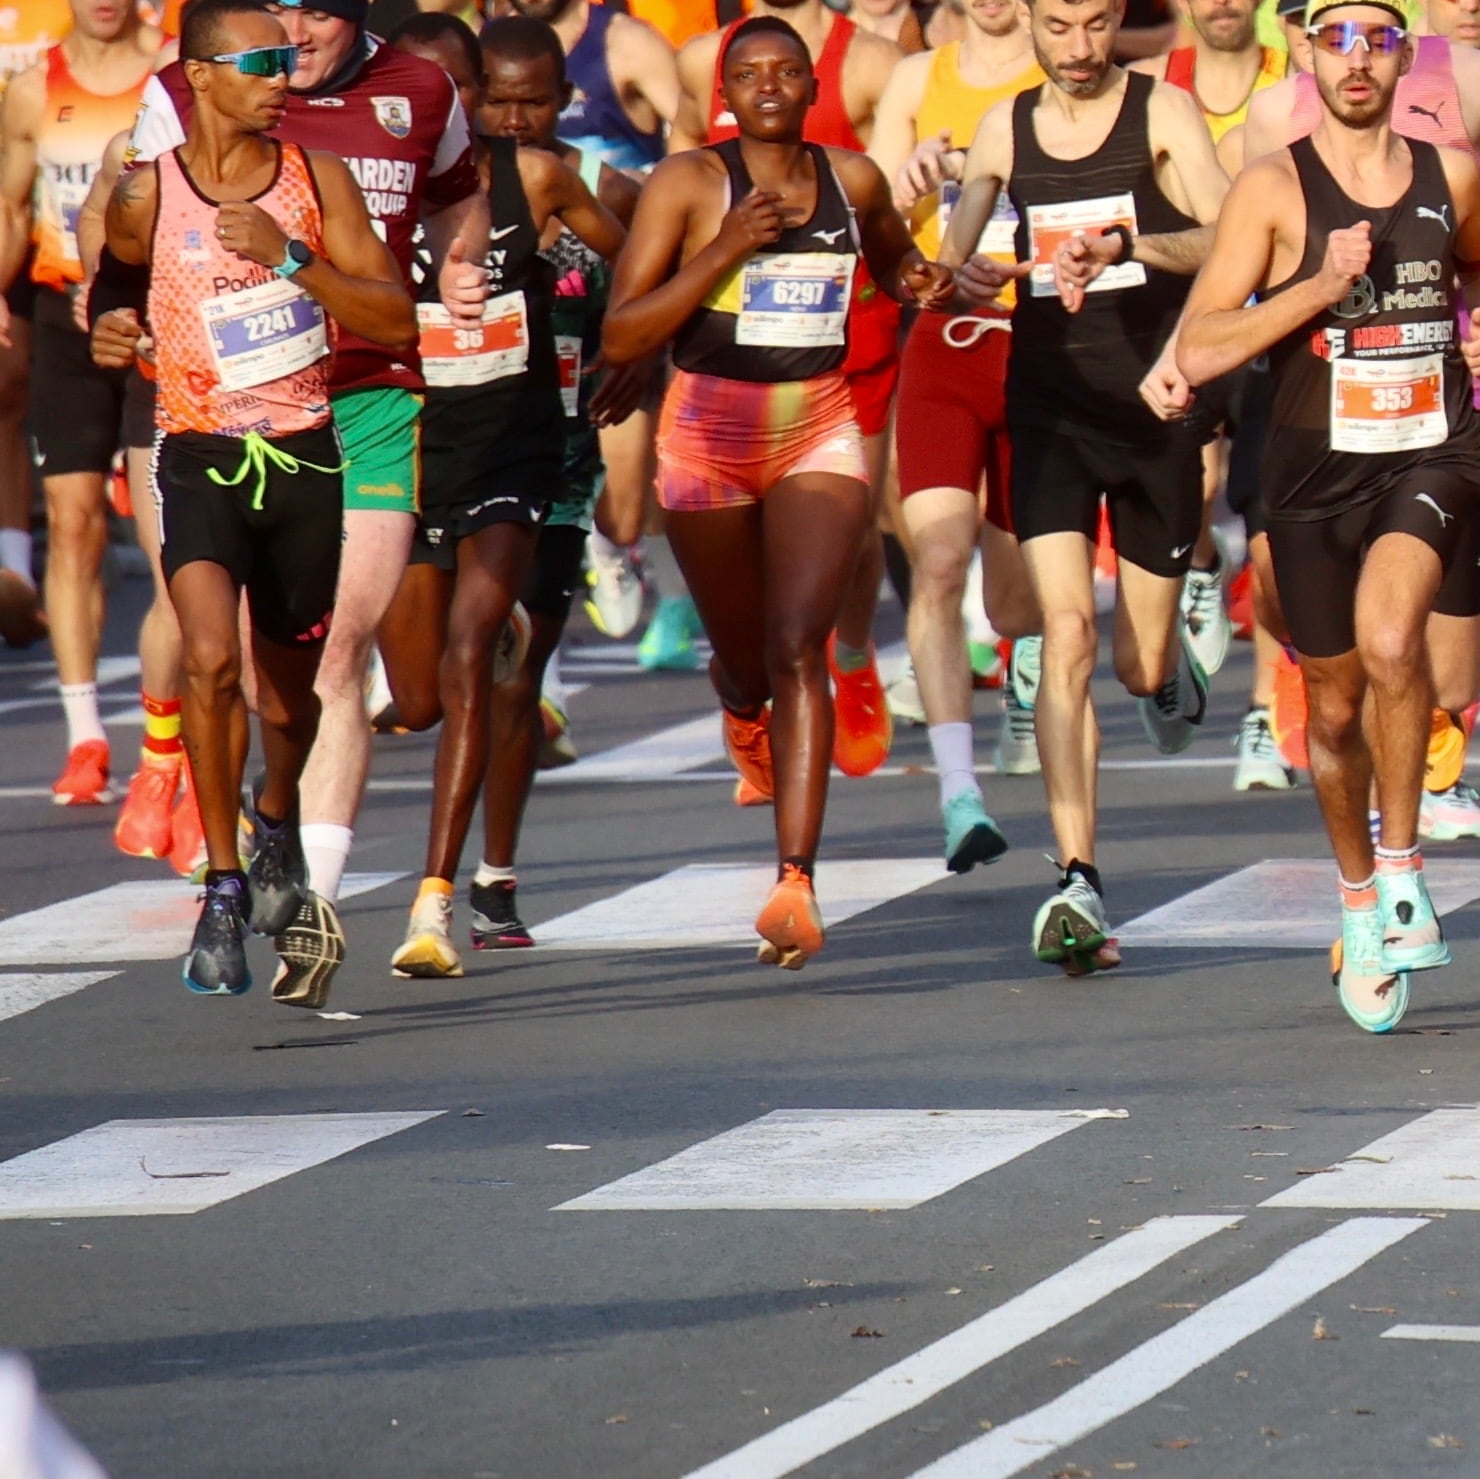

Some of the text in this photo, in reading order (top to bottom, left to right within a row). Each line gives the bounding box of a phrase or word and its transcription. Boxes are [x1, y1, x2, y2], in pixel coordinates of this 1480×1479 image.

[341, 158, 416, 194] ARDEN
[1394, 260, 1441, 285] HBO
[772, 280, 826, 305] 6297
[242, 305, 297, 342] 2241
[453, 329, 485, 351] 36
[1371, 386, 1413, 412] 353
